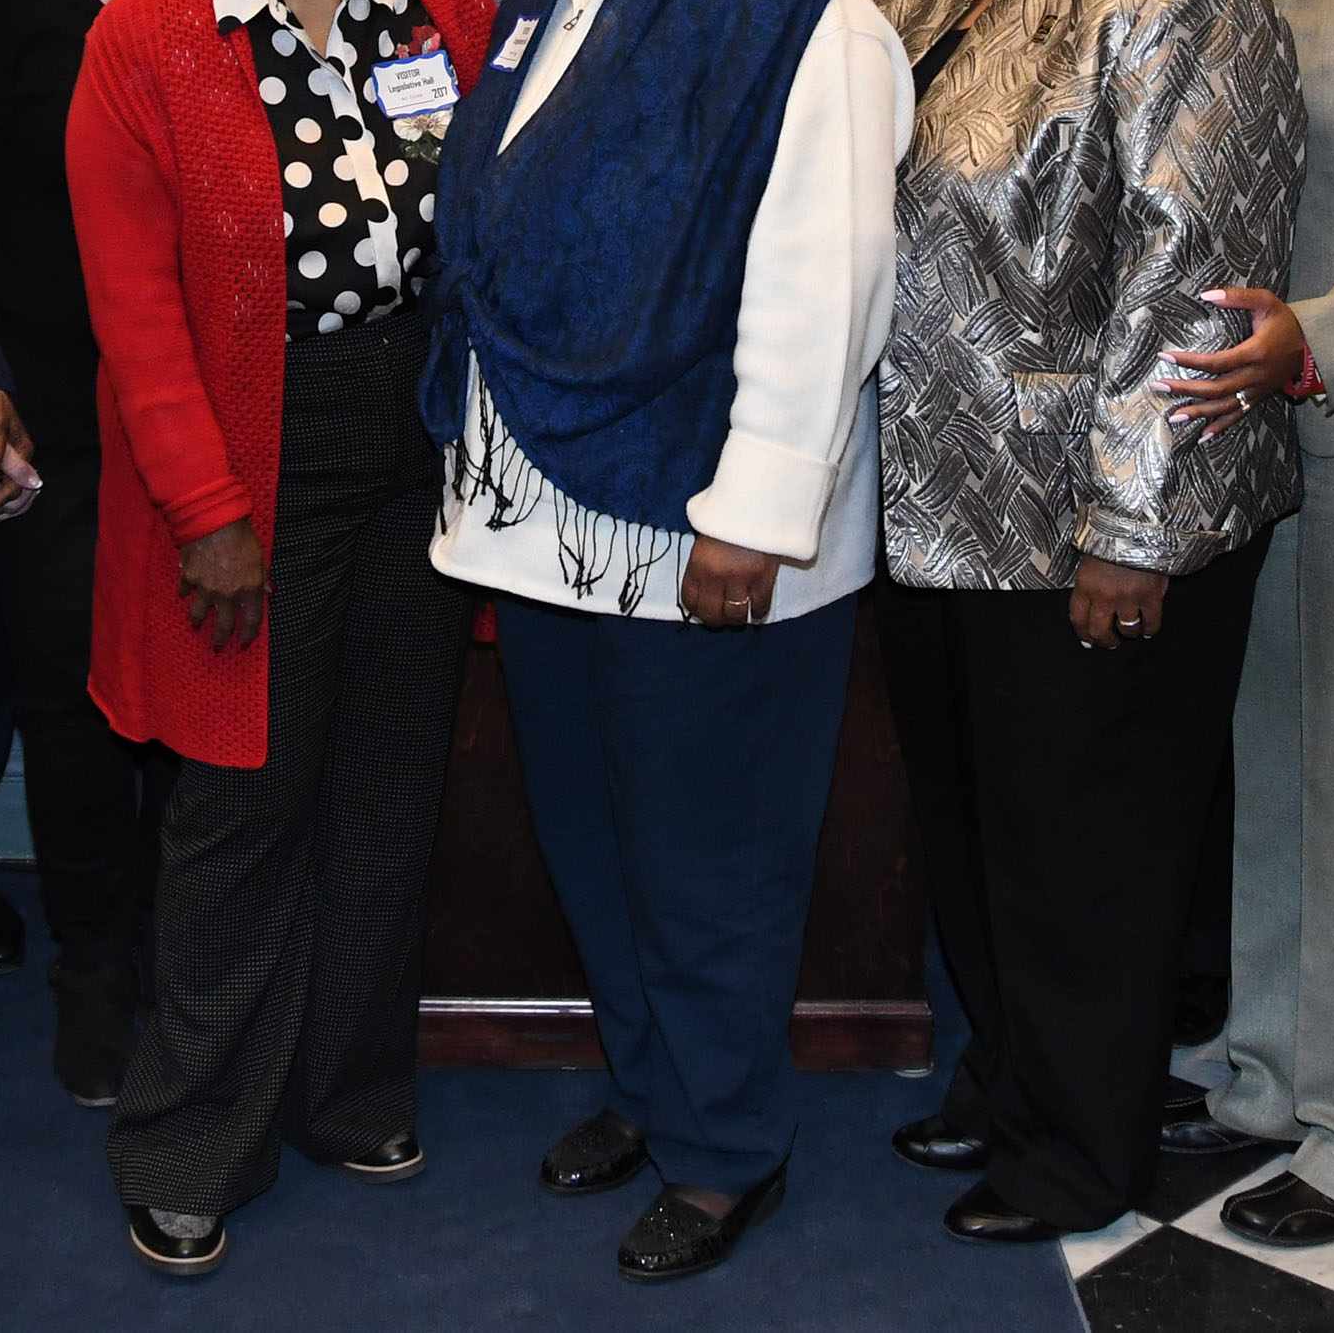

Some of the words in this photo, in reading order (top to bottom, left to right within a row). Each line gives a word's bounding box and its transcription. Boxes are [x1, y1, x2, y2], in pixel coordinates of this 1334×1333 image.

[395, 68, 421, 80] VISITOR
[422, 76, 435, 86] Hall
[431, 86, 448, 99] 207
